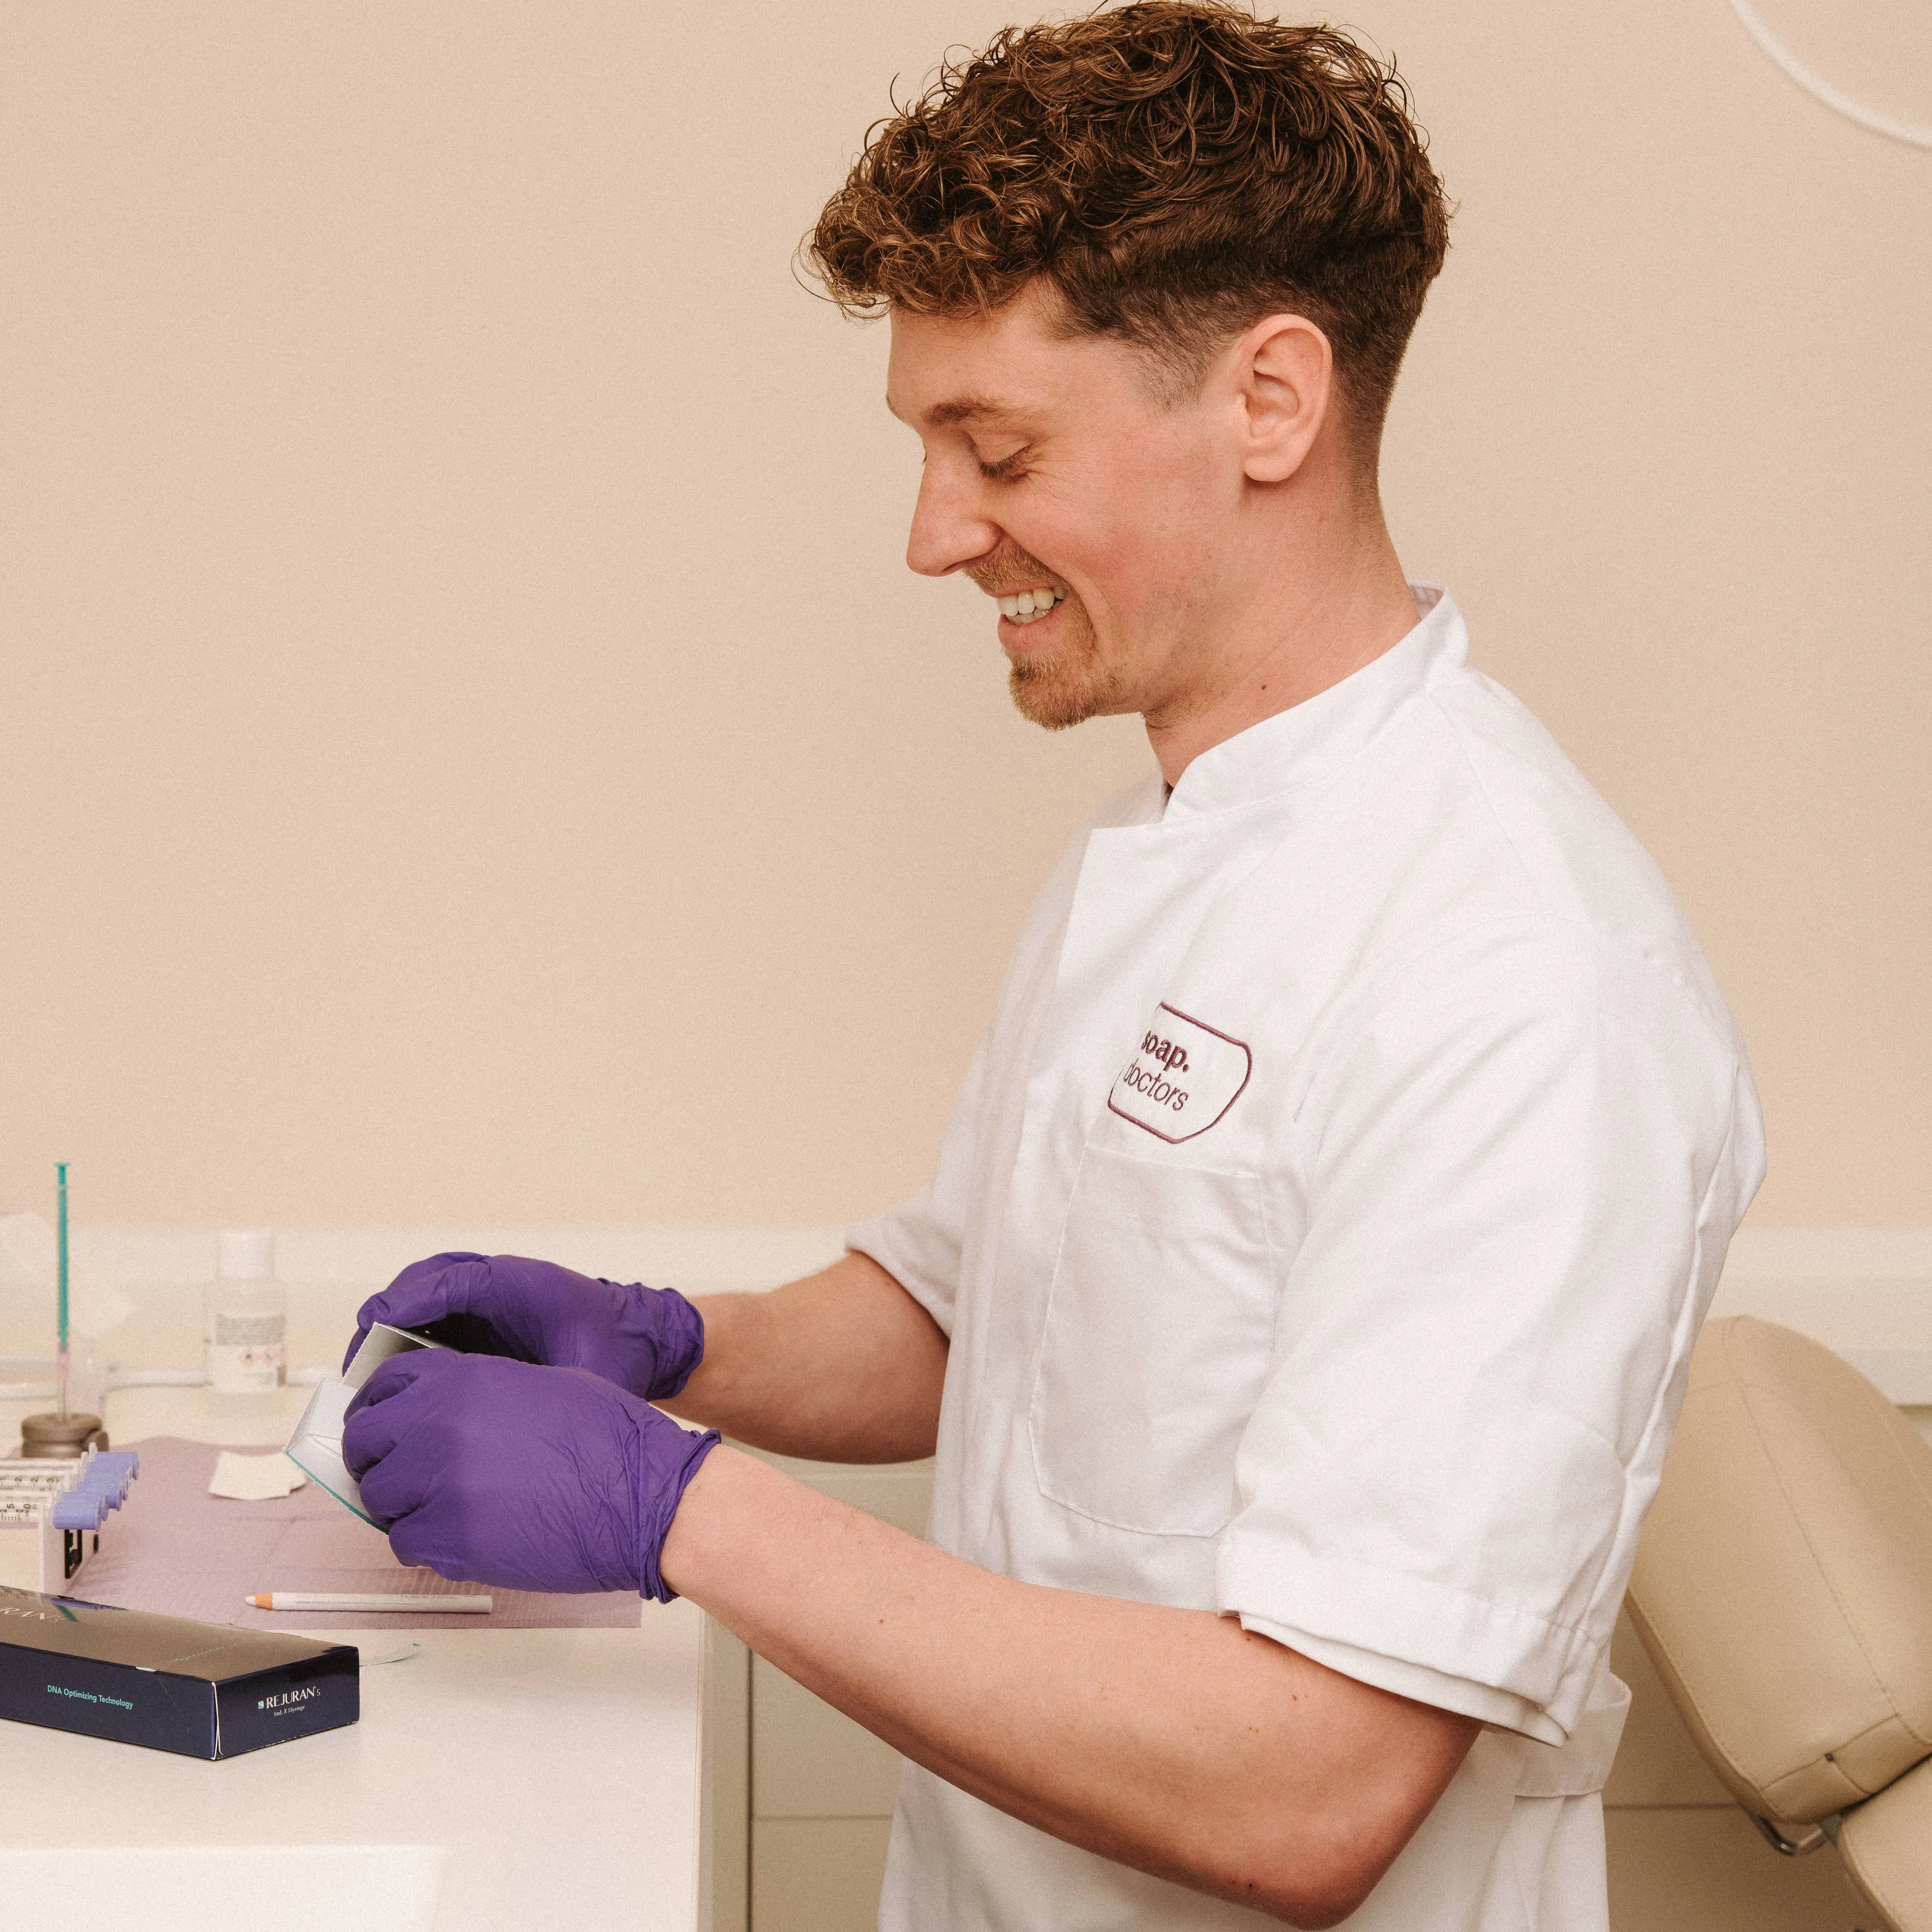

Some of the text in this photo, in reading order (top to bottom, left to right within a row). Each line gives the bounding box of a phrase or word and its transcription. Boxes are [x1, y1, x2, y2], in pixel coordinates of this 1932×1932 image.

[47, 1685, 133, 1710] DNA Optimizing Technology
